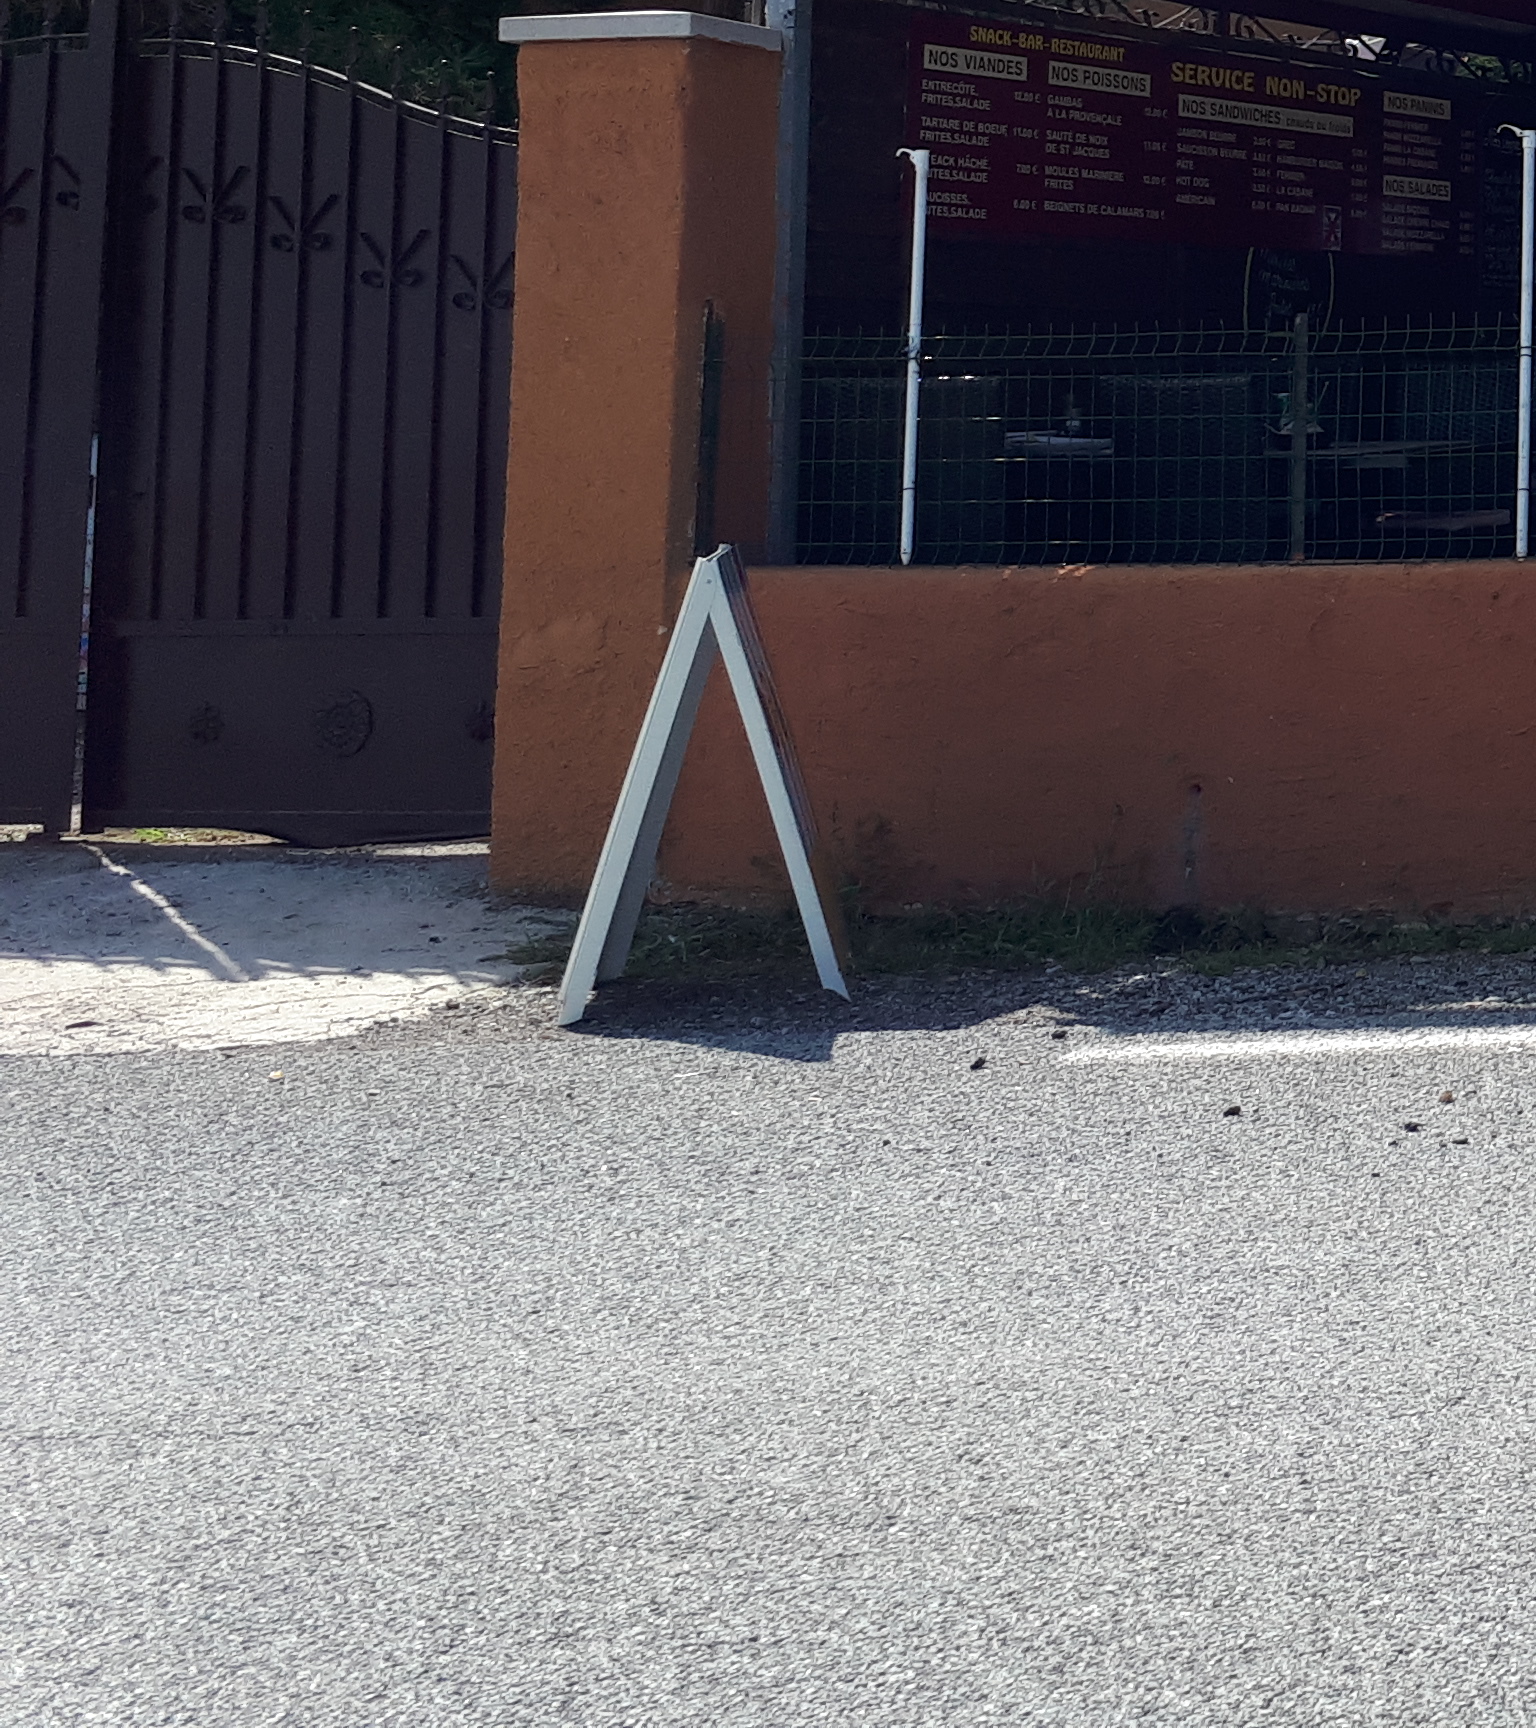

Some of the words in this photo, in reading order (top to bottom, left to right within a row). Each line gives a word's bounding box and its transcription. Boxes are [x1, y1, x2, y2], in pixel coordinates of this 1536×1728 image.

[928, 50, 958, 67] NOS
[965, 55, 1023, 75] VIANDES
[1051, 66, 1078, 82] NOS
[1083, 70, 1147, 92] POISSONS
[1170, 61, 1256, 93] SERVICE
[1265, 75, 1362, 107] NON-STOP
[1182, 99, 1206, 115] NOS
[1210, 103, 1281, 125] SANDWICHES
[1388, 97, 1408, 110] NOS
[920, 116, 960, 130] TARTARE
[962, 120, 975, 132] DE
[1385, 180, 1404, 193] NOS
[1408, 182, 1449, 197] SALADES
